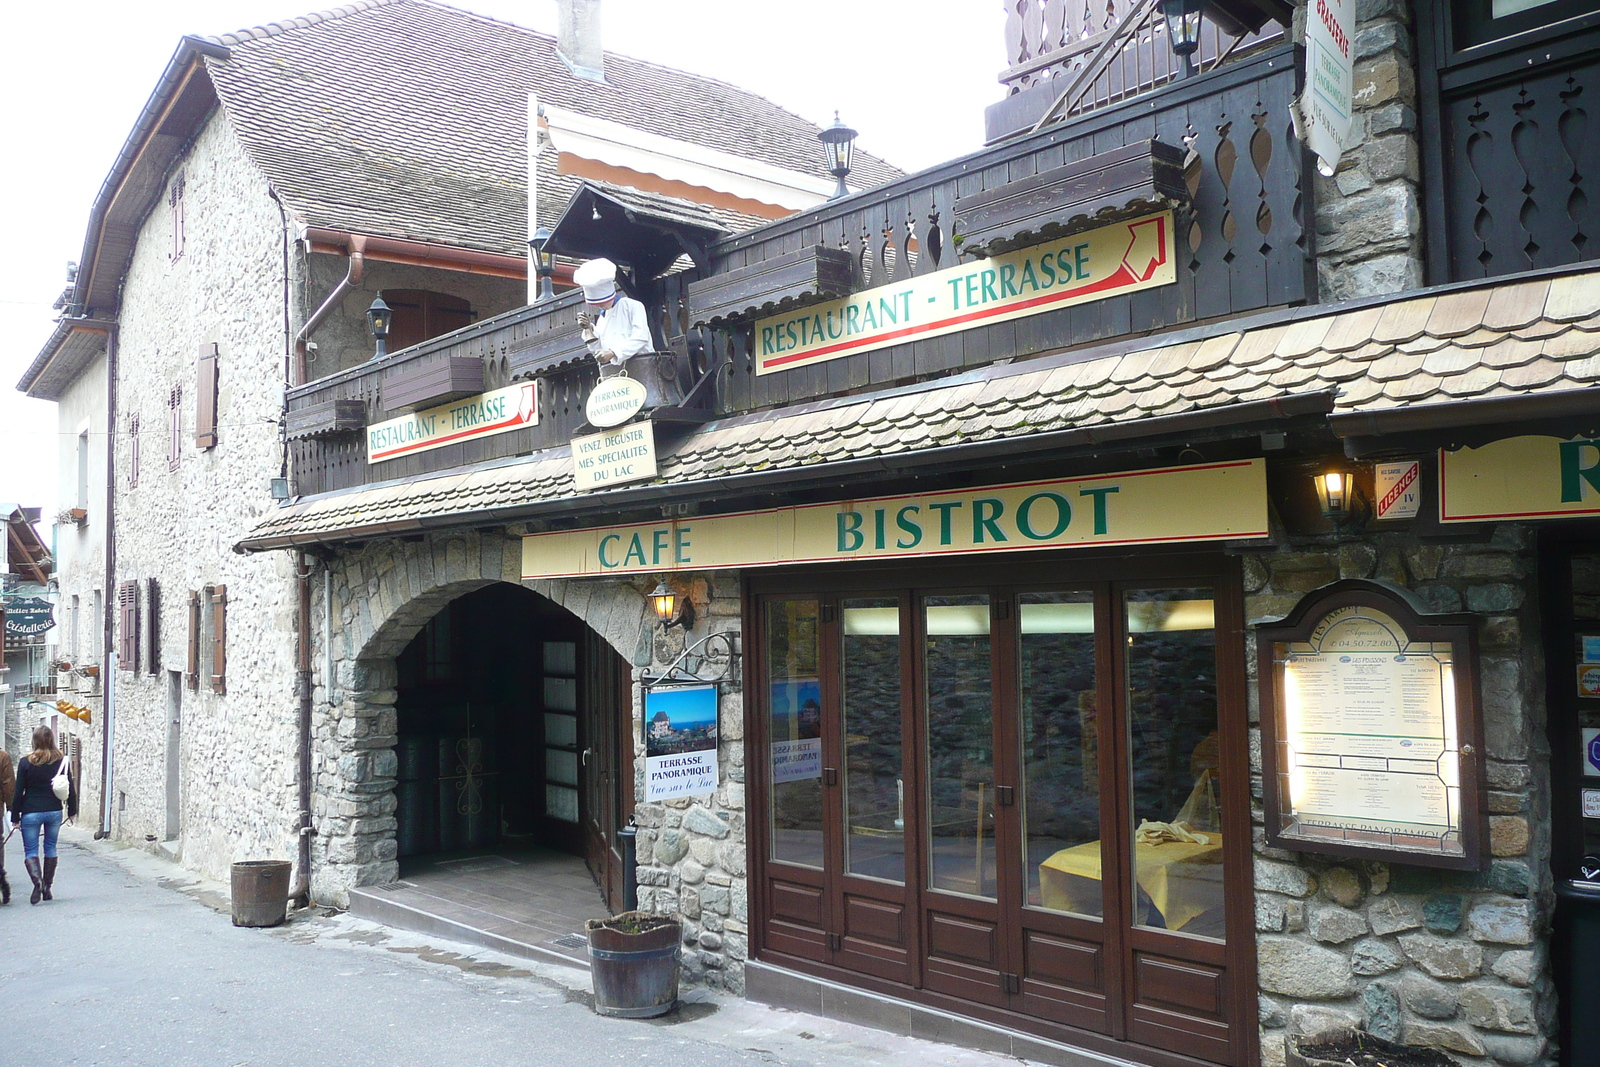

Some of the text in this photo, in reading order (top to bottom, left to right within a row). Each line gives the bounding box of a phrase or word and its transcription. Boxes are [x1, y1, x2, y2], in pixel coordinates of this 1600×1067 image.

[1316, 0, 1349, 59] BRASSERIE
[1321, 53, 1341, 85] TERRASSE
[1314, 67, 1347, 110] PANORAMIQUE
[1313, 99, 1321, 121] VUE
[1322, 112, 1331, 134] SUR
[762, 289, 914, 356] RESTAURANT
[947, 242, 1091, 311] TERRASSE
[594, 386, 631, 404] TERRASSE
[590, 398, 639, 419] PANORAMIQUE
[370, 414, 437, 450] RESTAURANT
[450, 396, 506, 430] TERRASSE
[579, 430, 644, 454] VENEZ DEGUSTER
[578, 444, 648, 470] MES SPECIALITES
[593, 464, 634, 481] DU LAC
[1380, 466, 1416, 515] LICENCE
[1404, 493, 1415, 503] IV
[598, 484, 1121, 569] CAFE BISTROT
[6, 619, 54, 633] Cristallerie
[651, 766, 712, 781] PANORAMIQUE
[659, 756, 703, 769] TERRASSE
[651, 784, 666, 795] Vue
[686, 779, 694, 790] le
